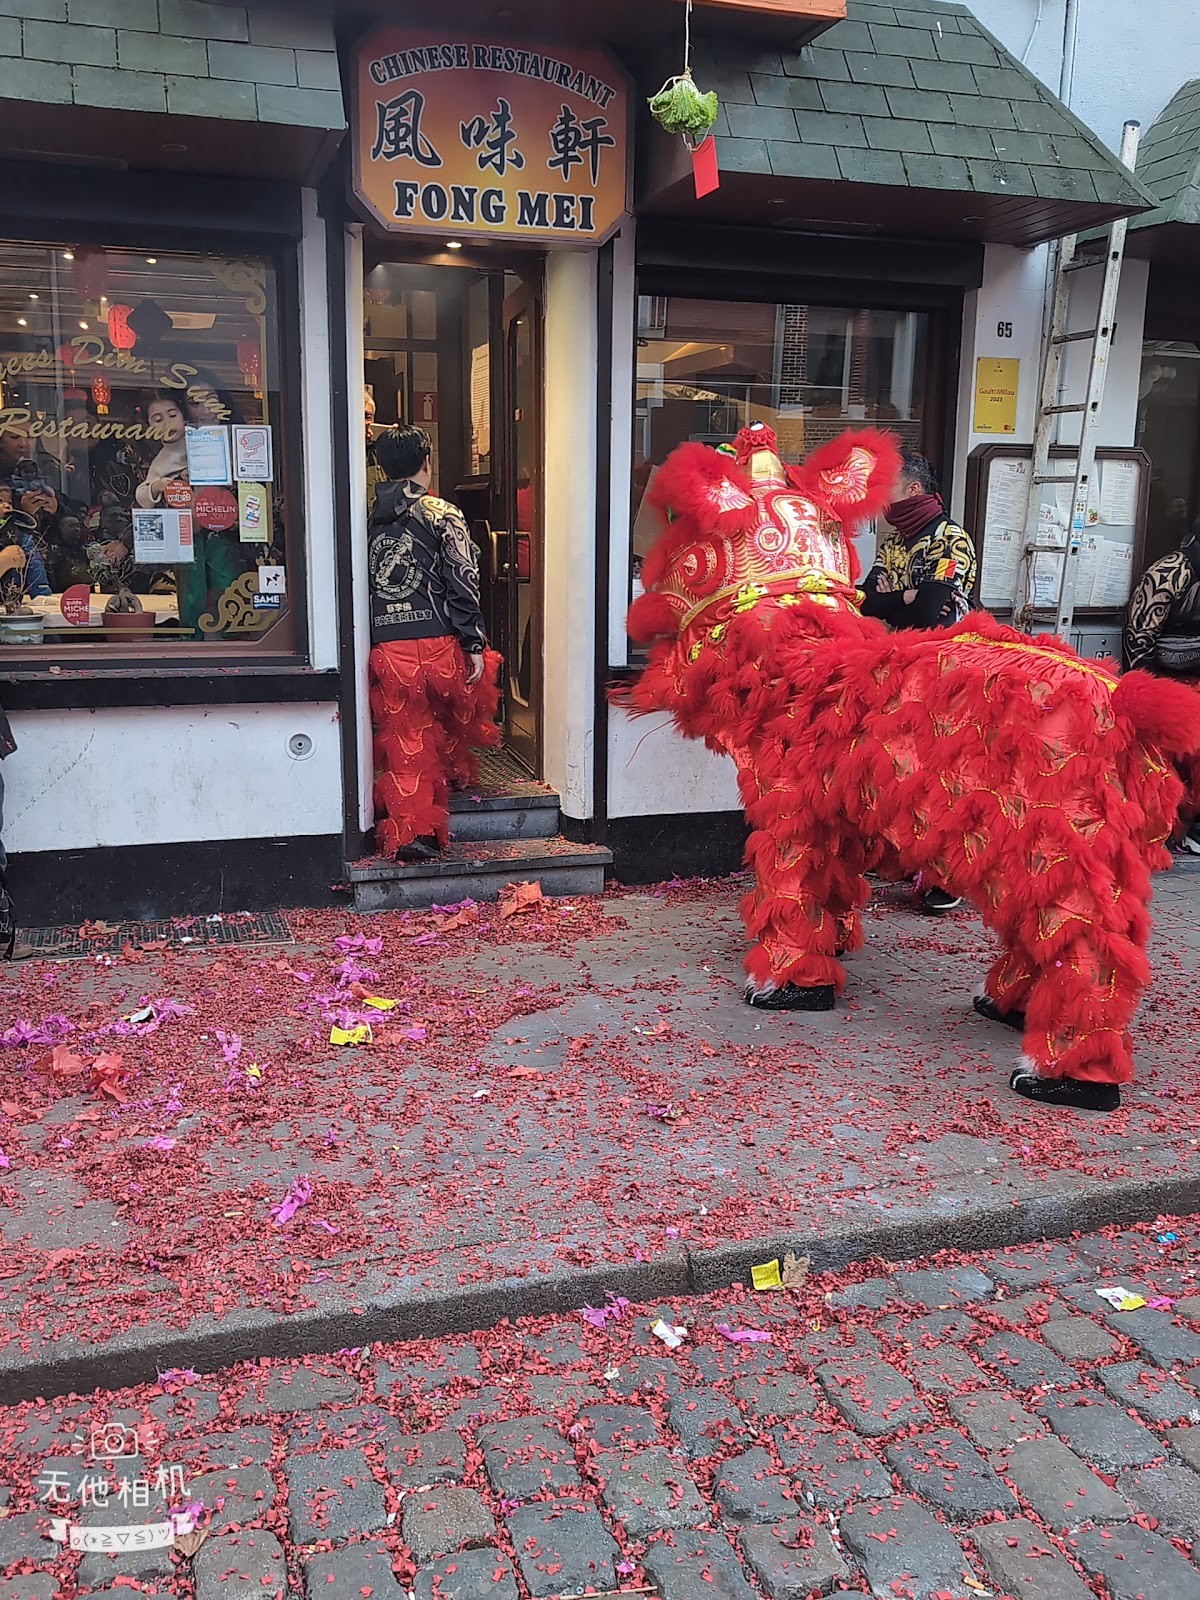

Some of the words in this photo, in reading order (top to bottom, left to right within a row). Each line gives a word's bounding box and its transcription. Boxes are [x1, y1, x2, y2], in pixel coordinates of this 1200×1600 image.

[370, 45, 468, 84] CHINESE
[473, 45, 616, 109] RESTAURANT
[371, 90, 615, 186] 風味軒
[394, 181, 506, 224] FONG
[517, 192, 595, 230] MEI
[997, 322, 1013, 338] 65
[195, 505, 236, 513] MICHELIN
[253, 595, 280, 604] SAME
